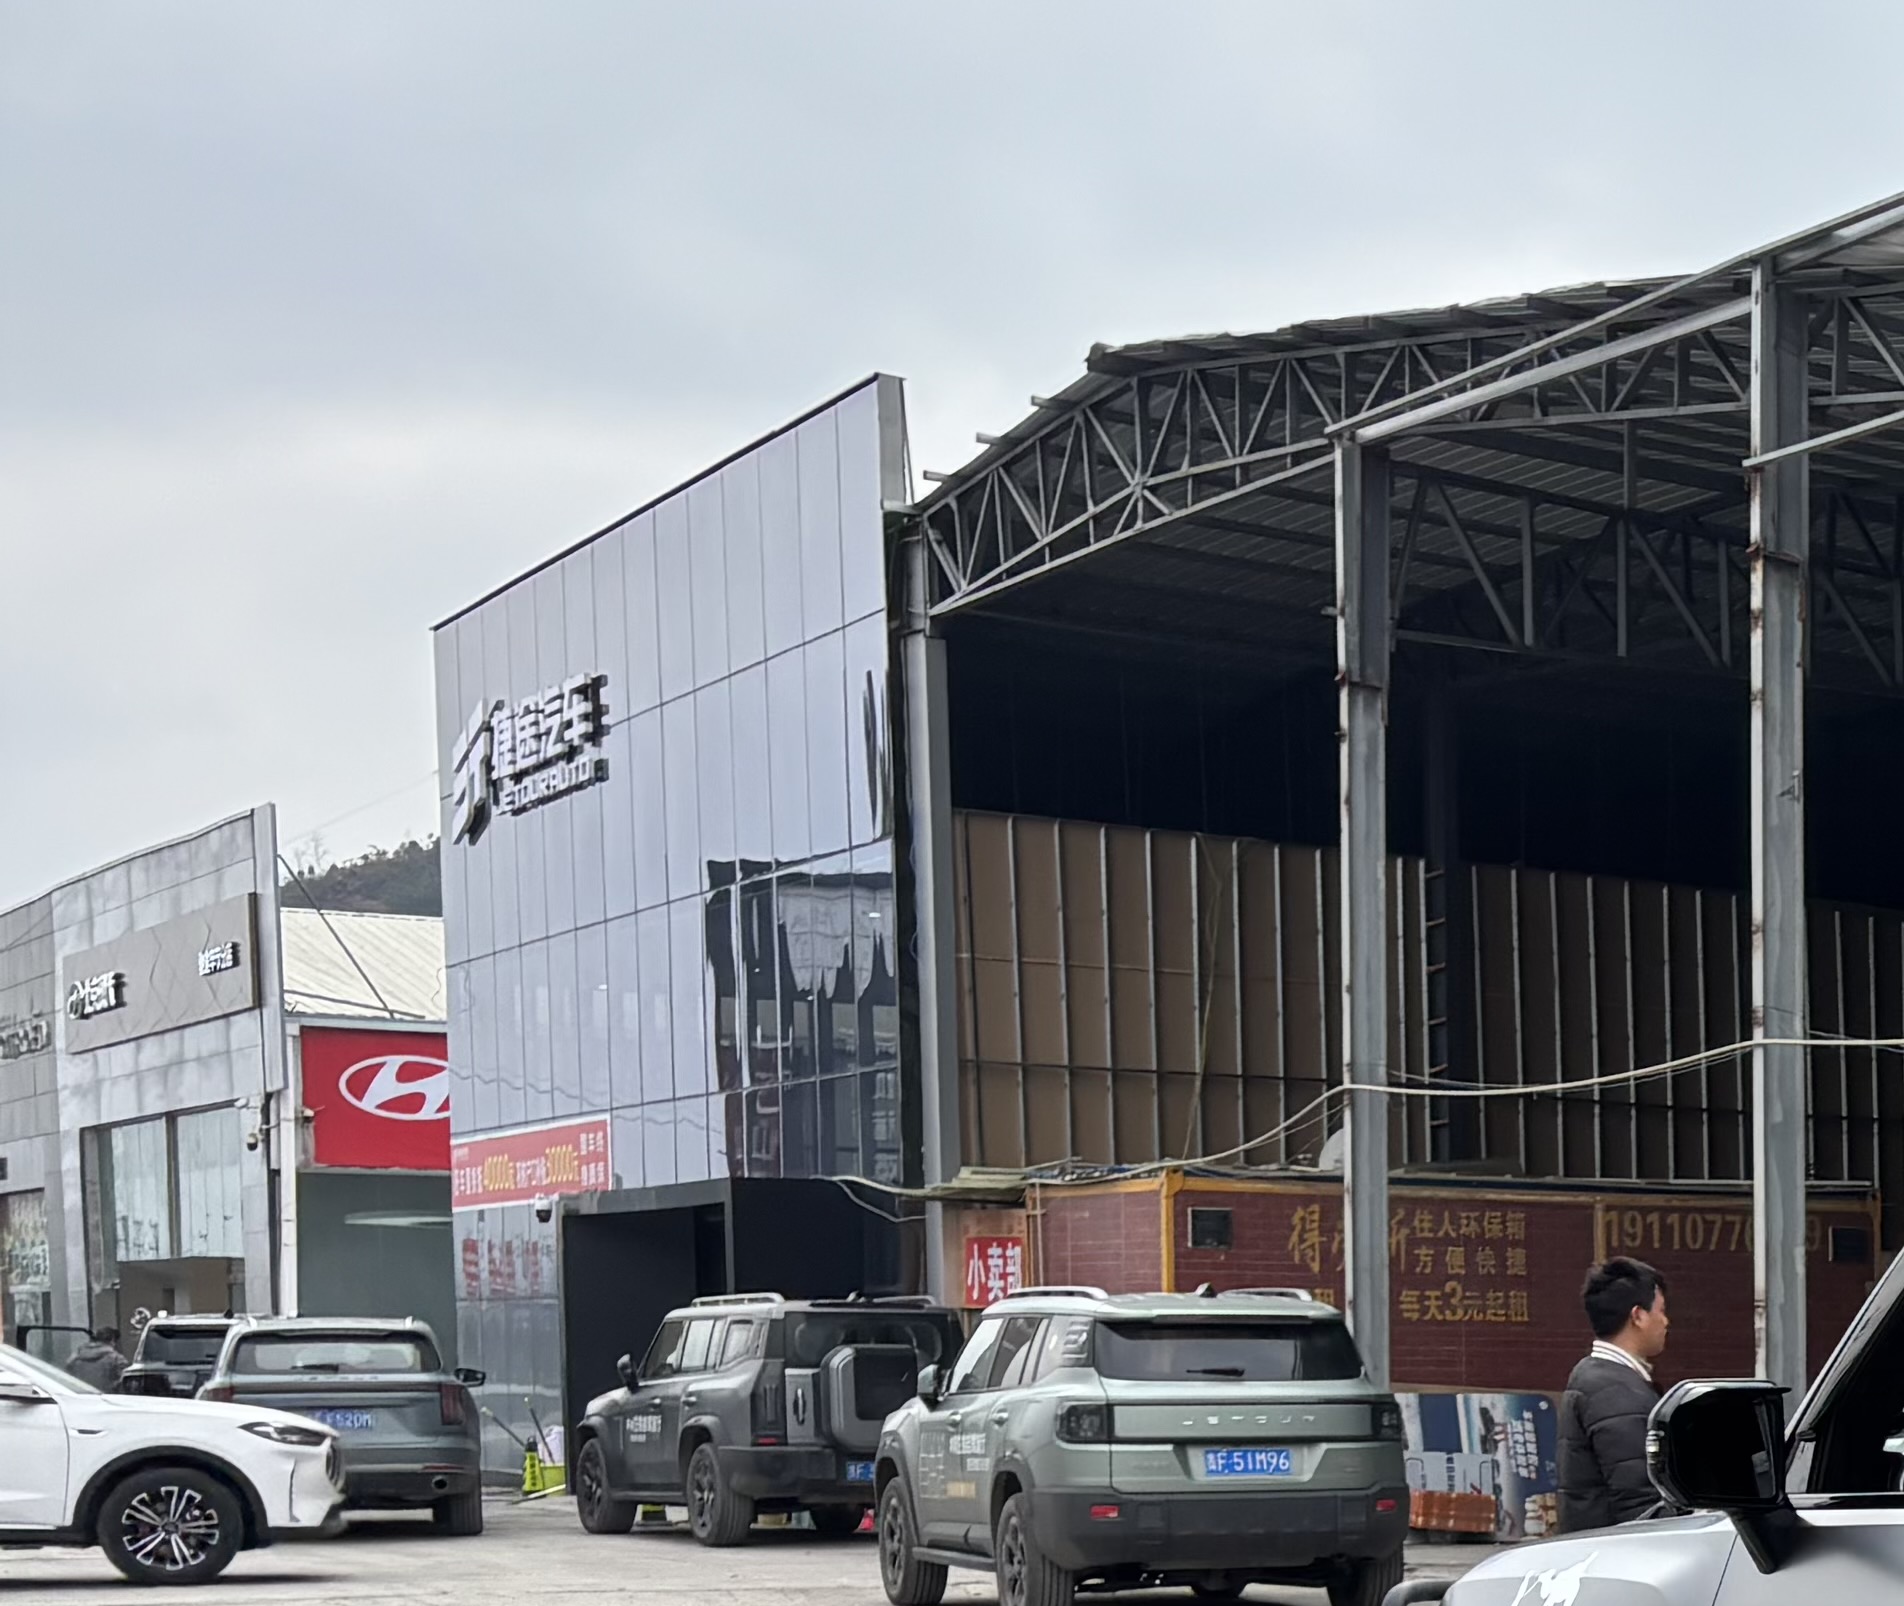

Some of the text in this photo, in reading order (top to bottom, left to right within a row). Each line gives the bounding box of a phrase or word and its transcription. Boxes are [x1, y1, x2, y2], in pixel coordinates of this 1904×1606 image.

[491, 673, 594, 780] 捷途汽车
[1412, 1210, 1527, 1240] 住人环保箱
[1413, 1246, 1528, 1276] 方便快捷
[1400, 1281, 1530, 1322] 每天3元起租
